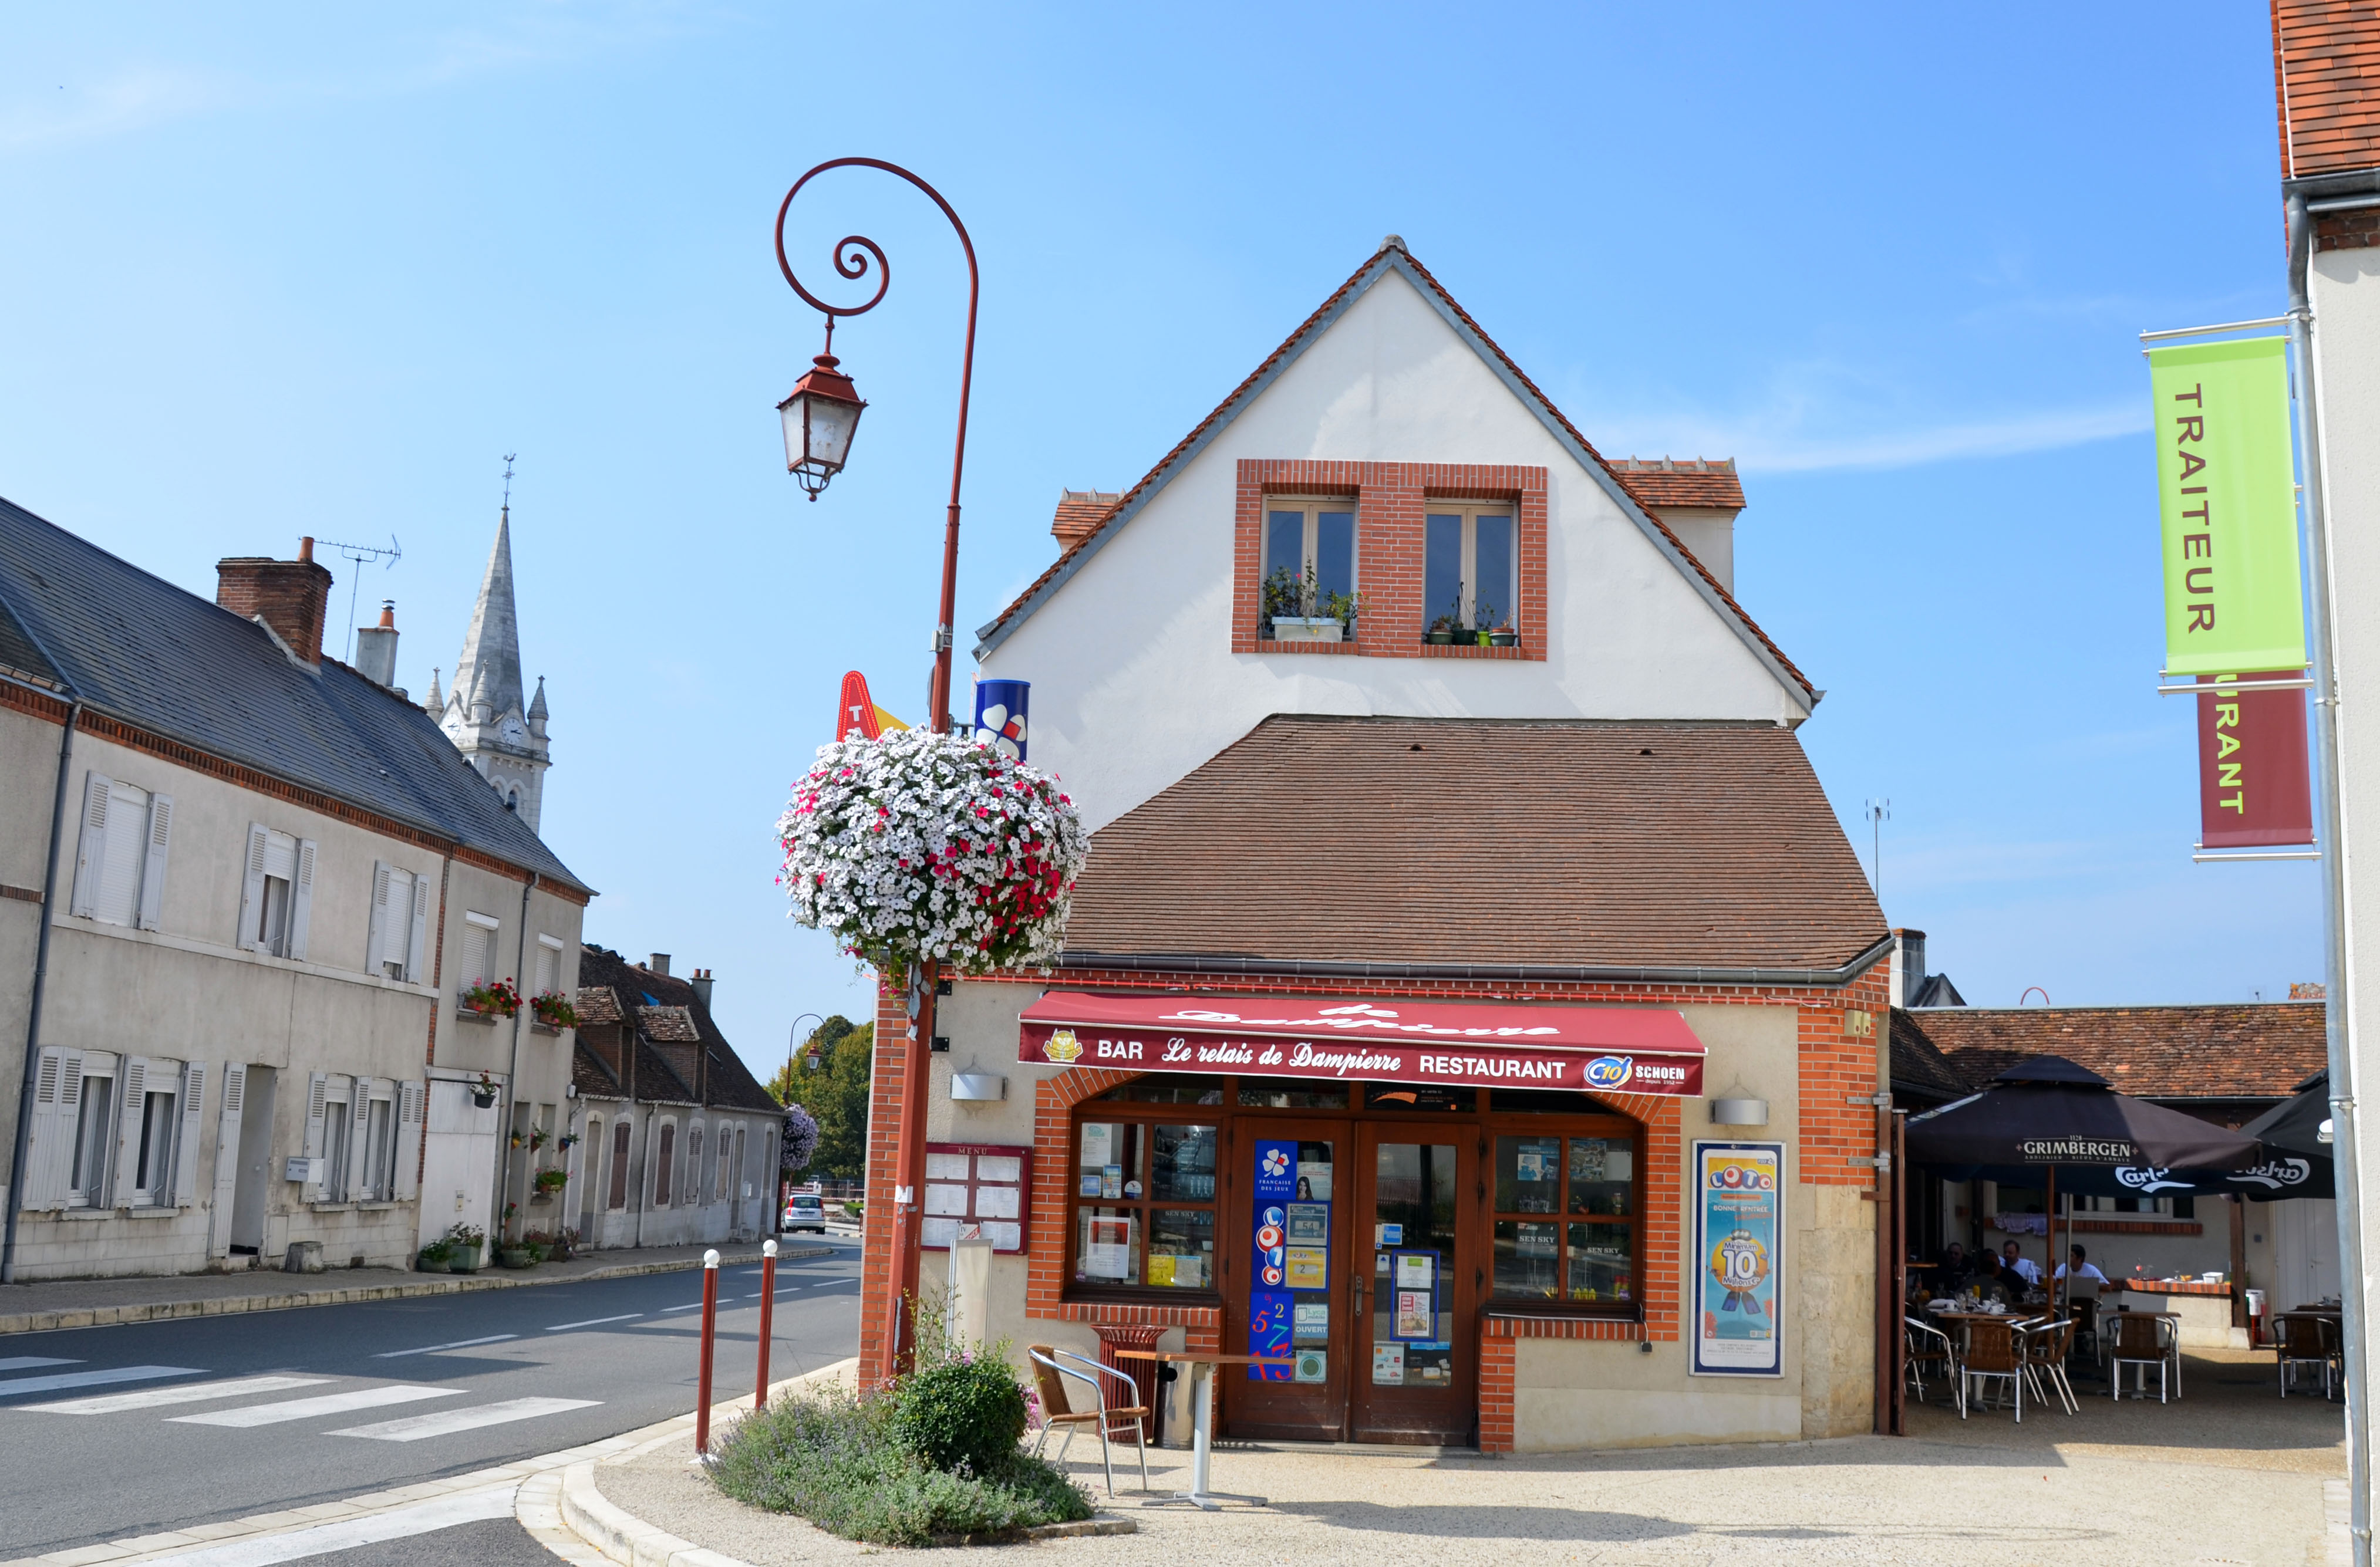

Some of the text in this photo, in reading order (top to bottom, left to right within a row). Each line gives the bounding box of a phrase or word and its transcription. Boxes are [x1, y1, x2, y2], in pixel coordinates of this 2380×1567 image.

[2175, 383, 2216, 634] TRAITEUR
[1097, 1039, 1144, 1060] BAR
[1161, 1037, 1401, 1076] Le relais de Dampierre
[1419, 1055, 1566, 1079] RESTAURANT
[1589, 1062, 1623, 1080] C10
[1635, 1065, 1685, 1080] SCHOEN
[958, 1147, 987, 1155] MENU
[2024, 1141, 2130, 1157] GRIMBERGEN
[1710, 1164, 1772, 1190] LOTO
[1303, 1221, 1314, 1231] 54
[1519, 1235, 1555, 1244] SEN SKY
[1724, 1241, 1758, 1251] Minimum
[1300, 1264, 1306, 1274] 2
[1721, 1249, 1758, 1280] 10
[1722, 1276, 1752, 1286] Millions
[1275, 1303, 1285, 1319] 2
[1252, 1309, 1271, 1333] 5
[1266, 1323, 1289, 1349] 7
